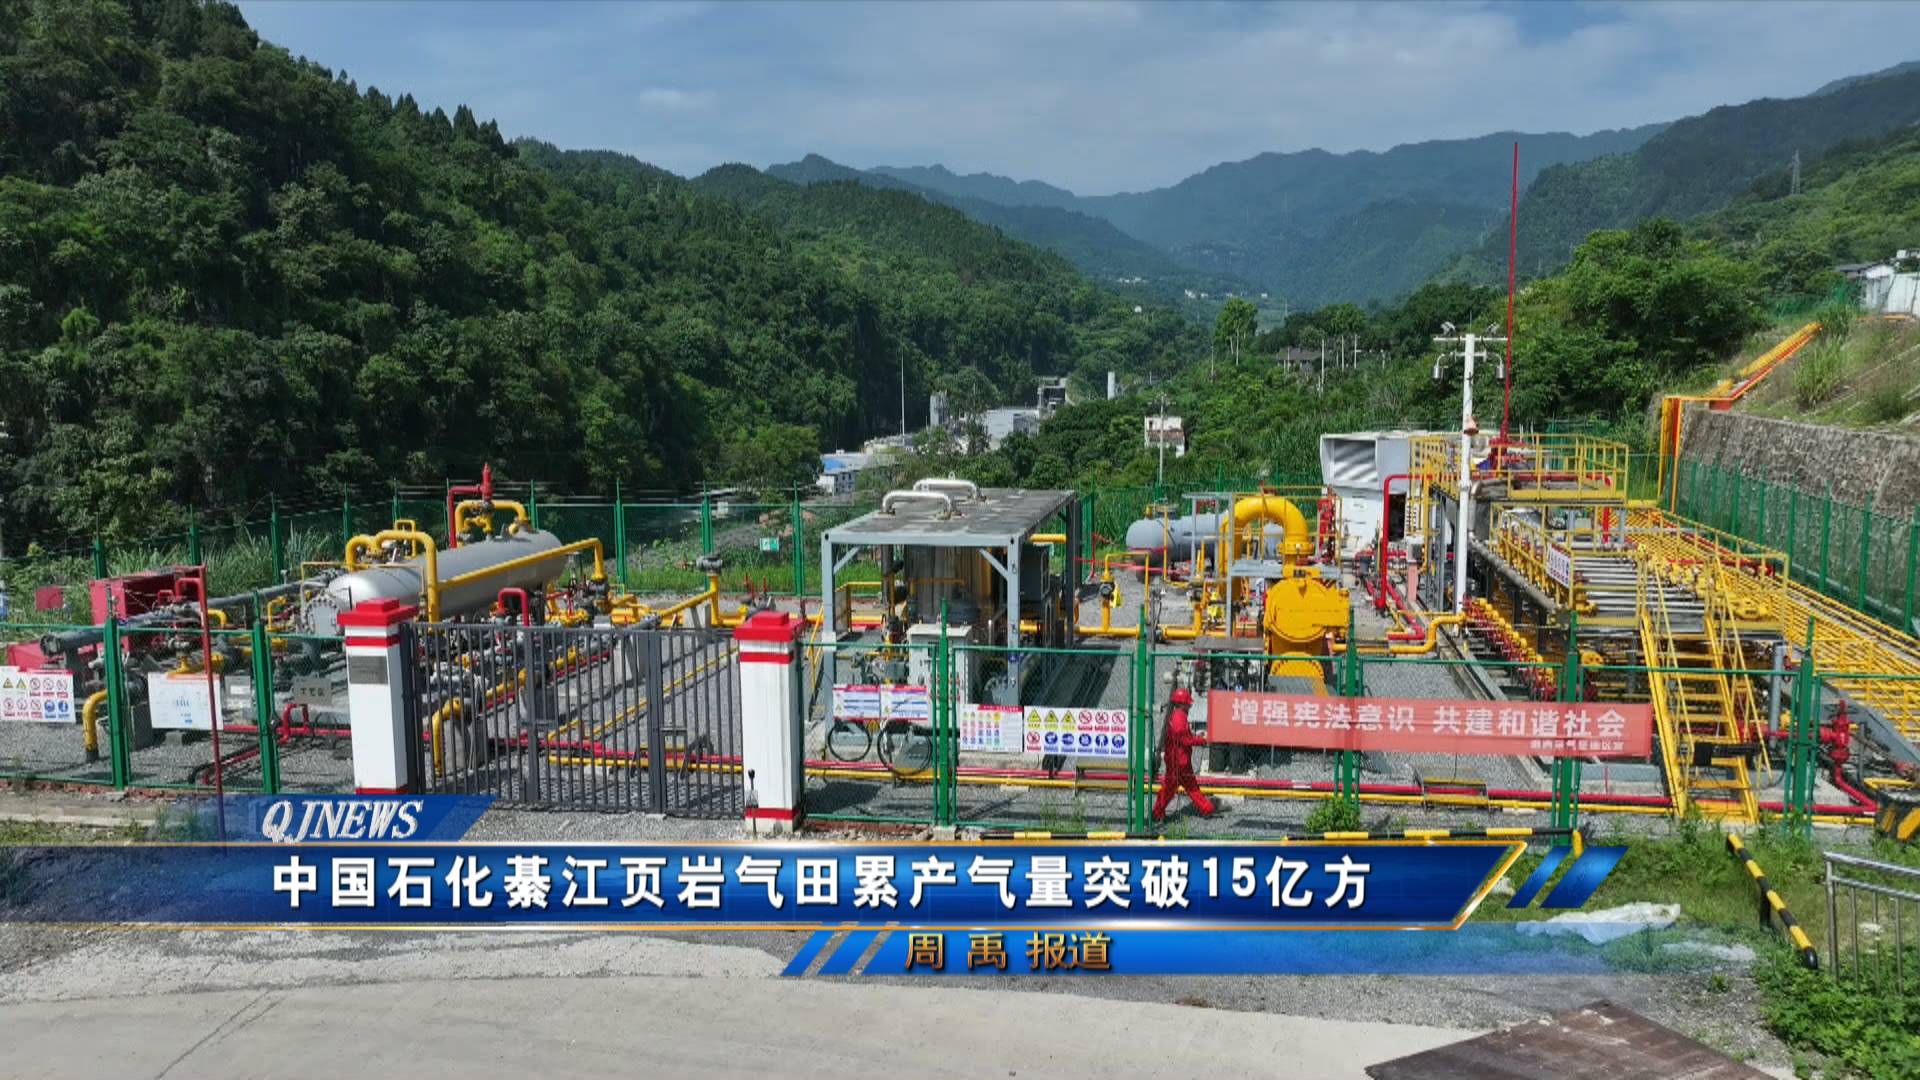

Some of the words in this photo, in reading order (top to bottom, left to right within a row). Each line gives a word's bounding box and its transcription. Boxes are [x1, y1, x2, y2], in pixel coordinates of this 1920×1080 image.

[1231, 698, 1415, 732] 增强宪法意识
[1433, 704, 1626, 737] 共建和谐社会
